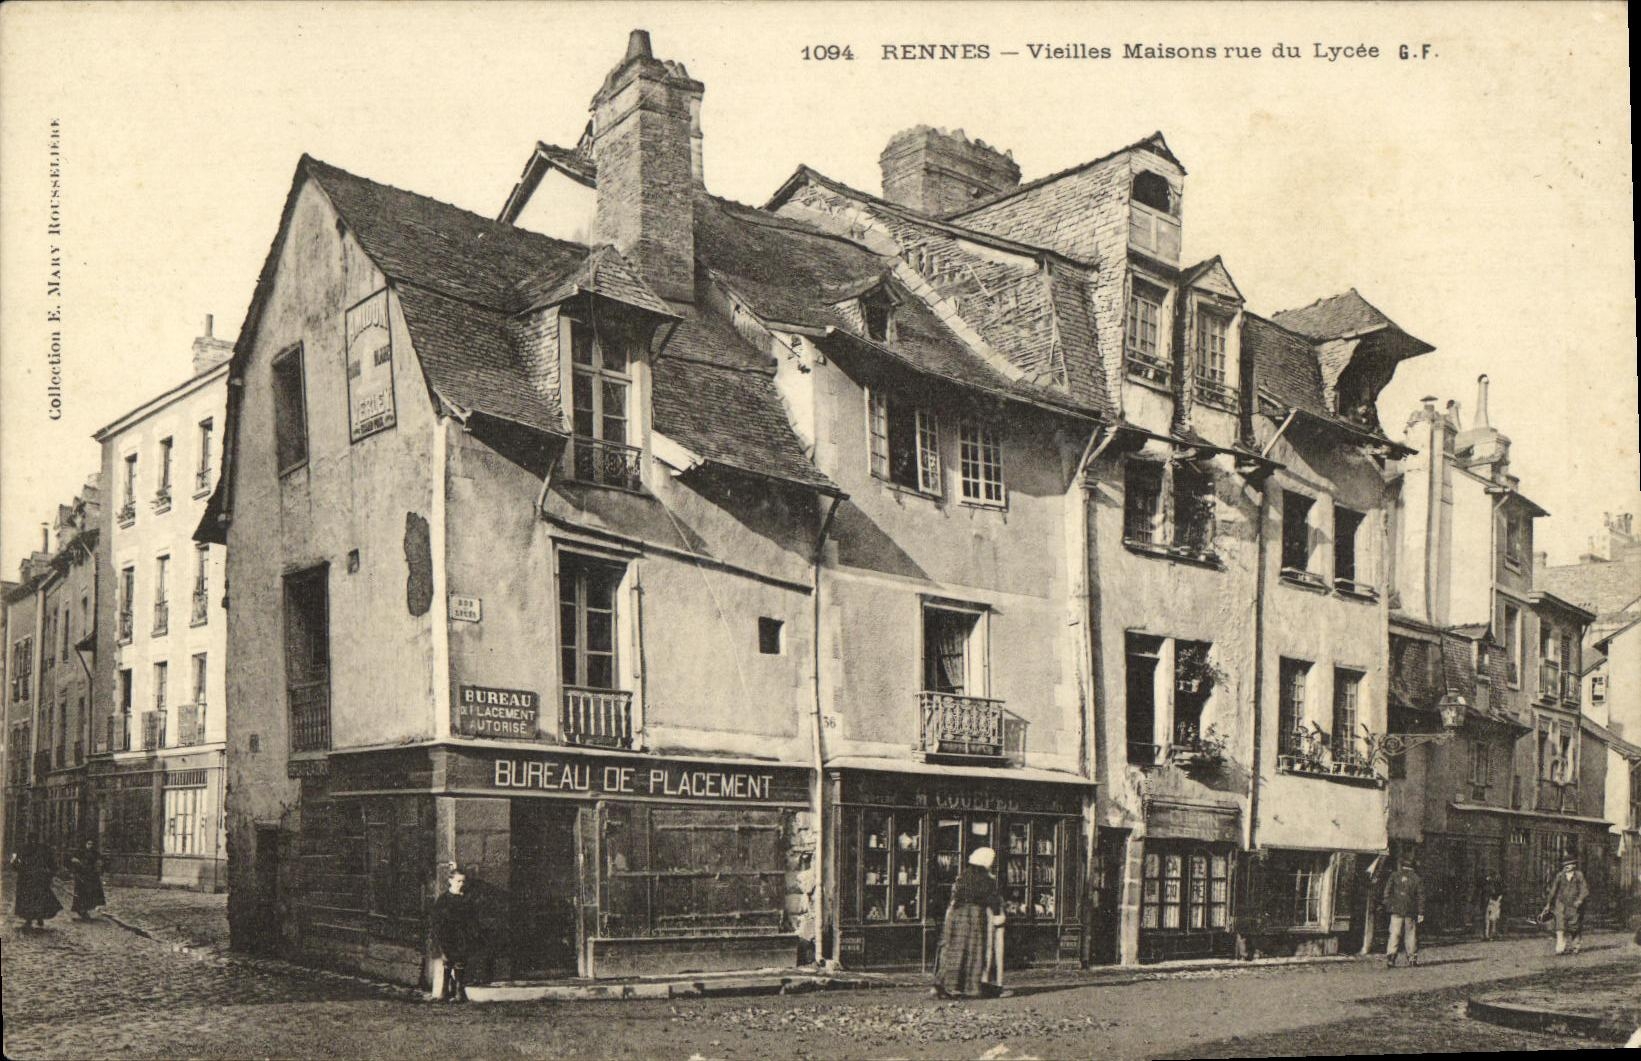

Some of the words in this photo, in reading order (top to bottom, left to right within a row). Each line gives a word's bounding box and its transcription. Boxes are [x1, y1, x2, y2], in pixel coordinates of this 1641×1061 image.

[464, 689, 532, 707] BUREAU
[494, 759, 590, 790] BUREAU
[603, 766, 634, 792] DE
[649, 769, 774, 798] PLACEMENT
